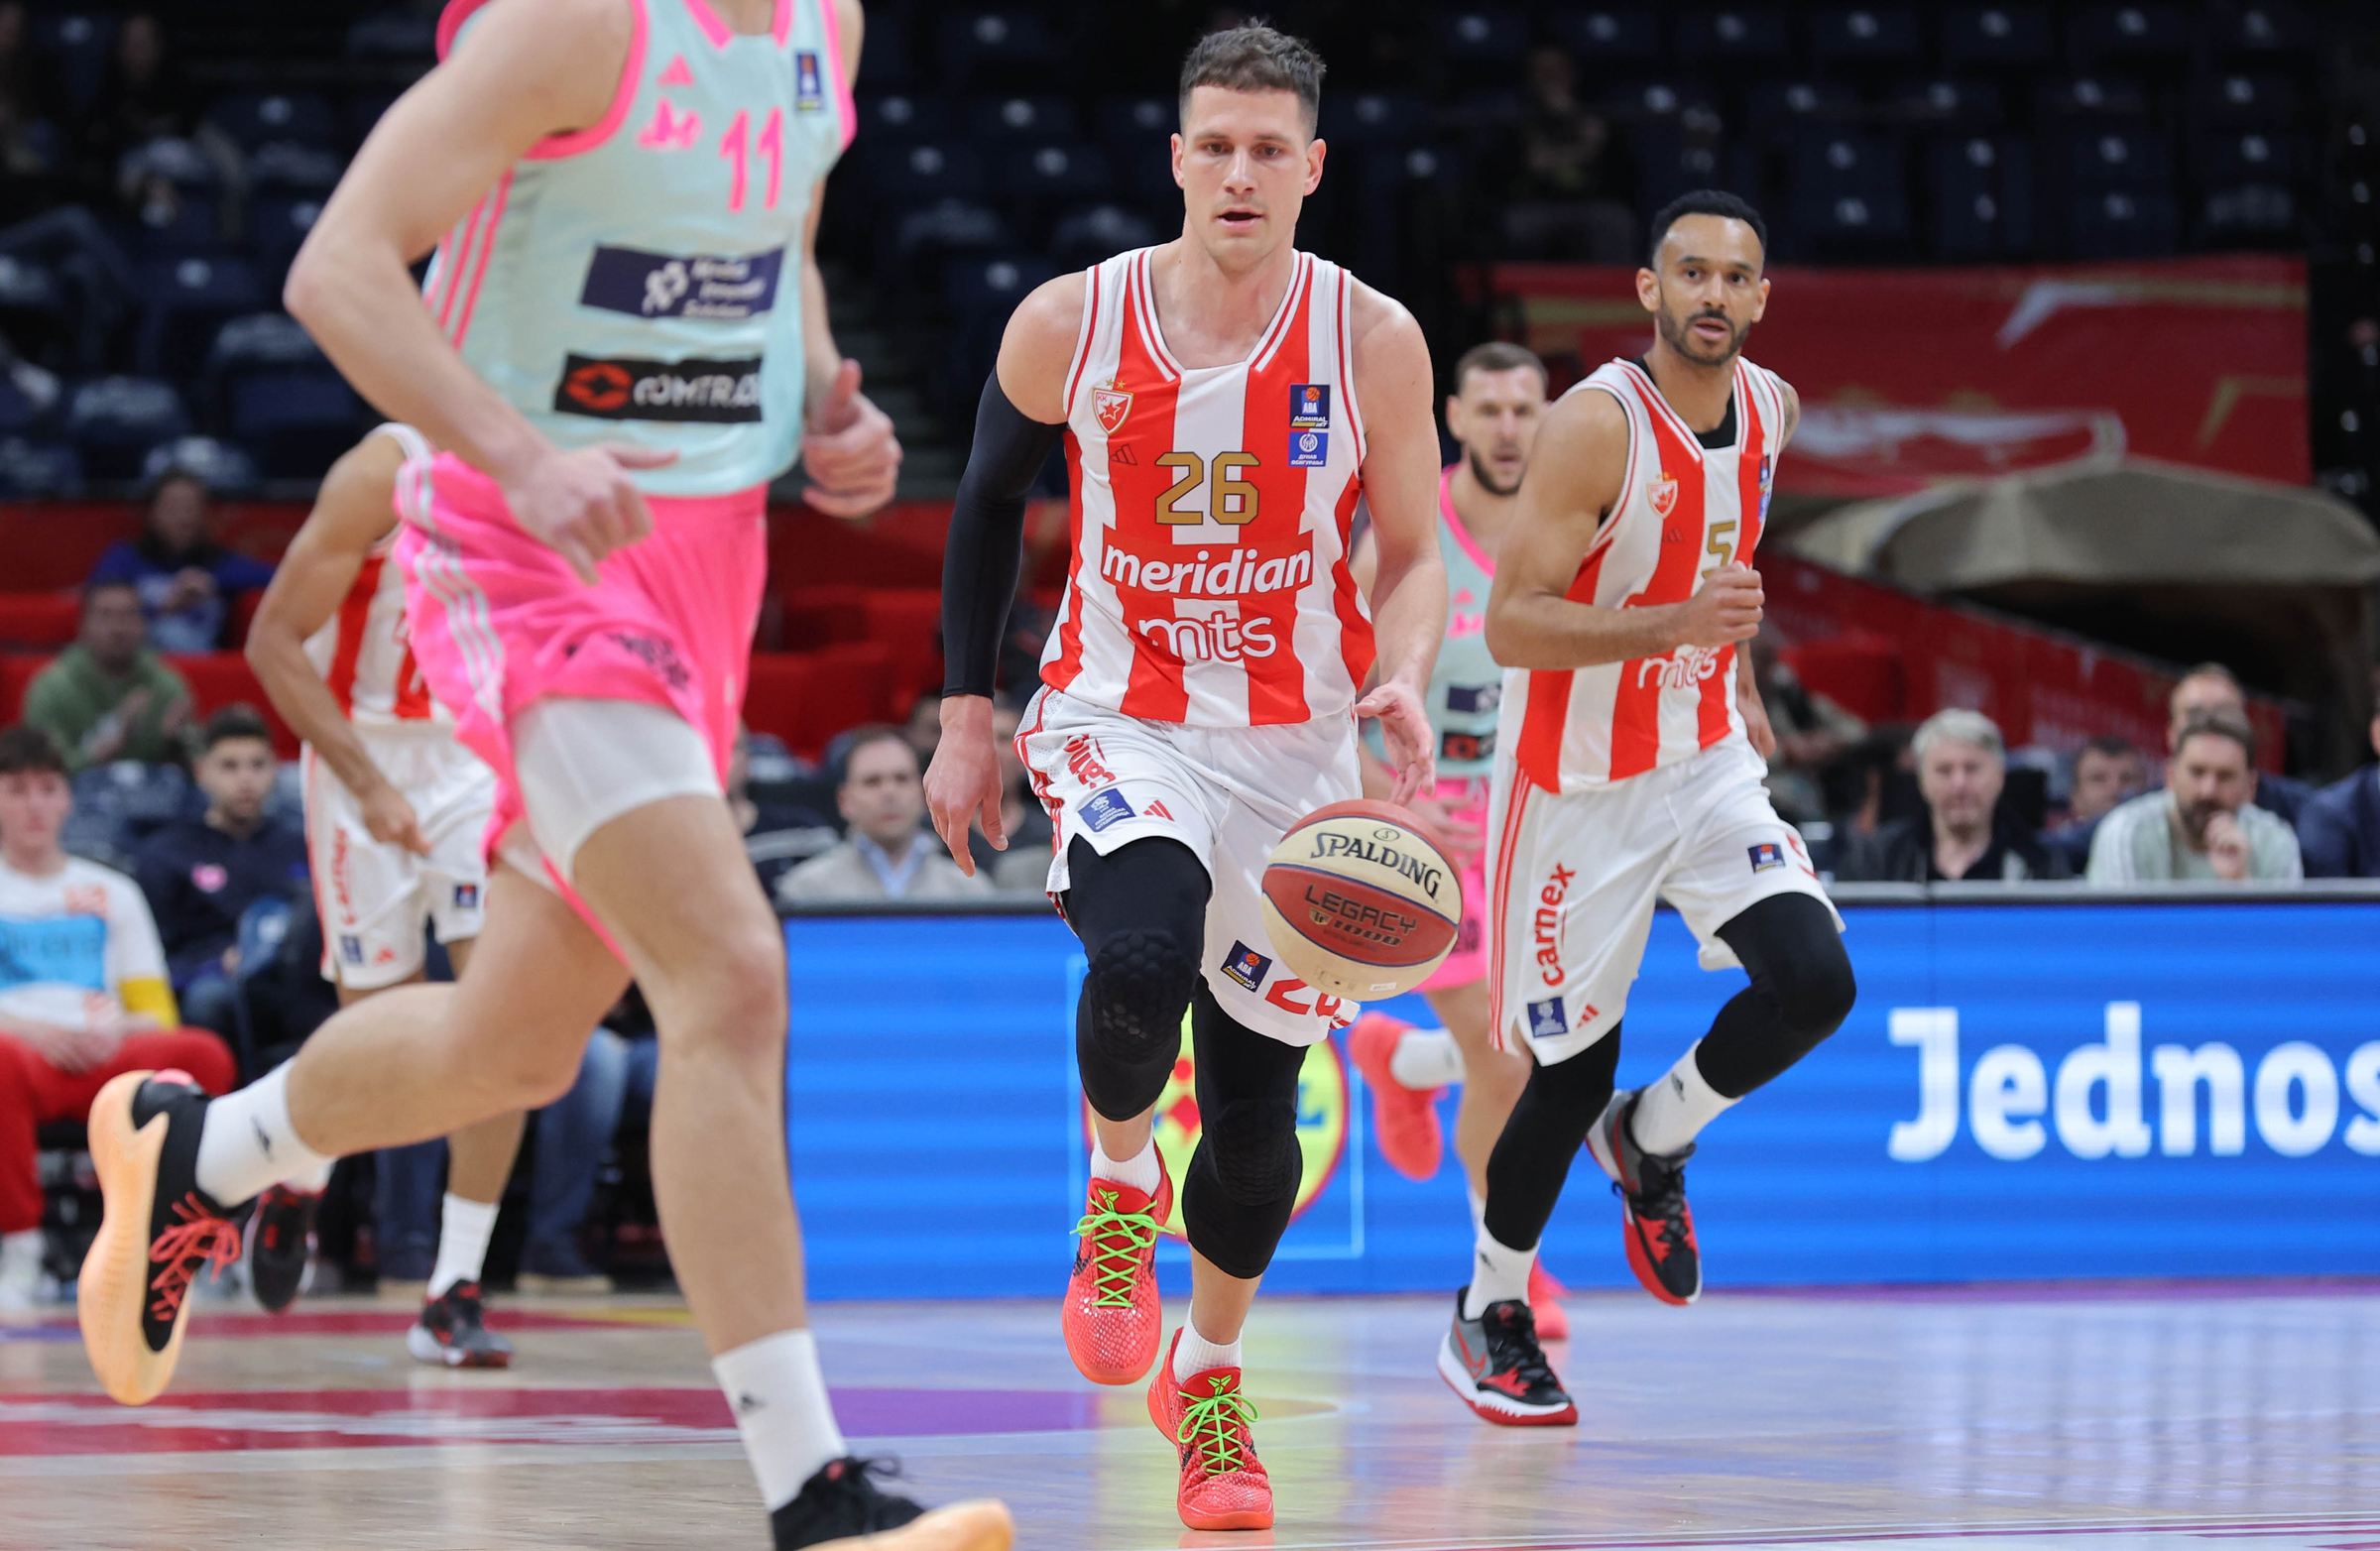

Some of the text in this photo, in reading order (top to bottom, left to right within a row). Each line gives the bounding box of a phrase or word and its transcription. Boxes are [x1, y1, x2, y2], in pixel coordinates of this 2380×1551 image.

[719, 106, 783, 213] 11
[1302, 402, 1318, 414] ABA
[1155, 451, 1260, 525] 26
[1102, 544, 1312, 596] meridian
[1702, 520, 1736, 580] 5
[1138, 612, 1277, 660] mts
[1637, 646, 1722, 690] mts
[1310, 832, 1443, 899] SPALDING
[1305, 884, 1418, 935] LEGACY
[1334, 919, 1402, 947] 1000
[1535, 862, 1577, 988] carnex
[1227, 965, 1256, 986] ADMIRAL
[1237, 961, 1253, 976] ABA
